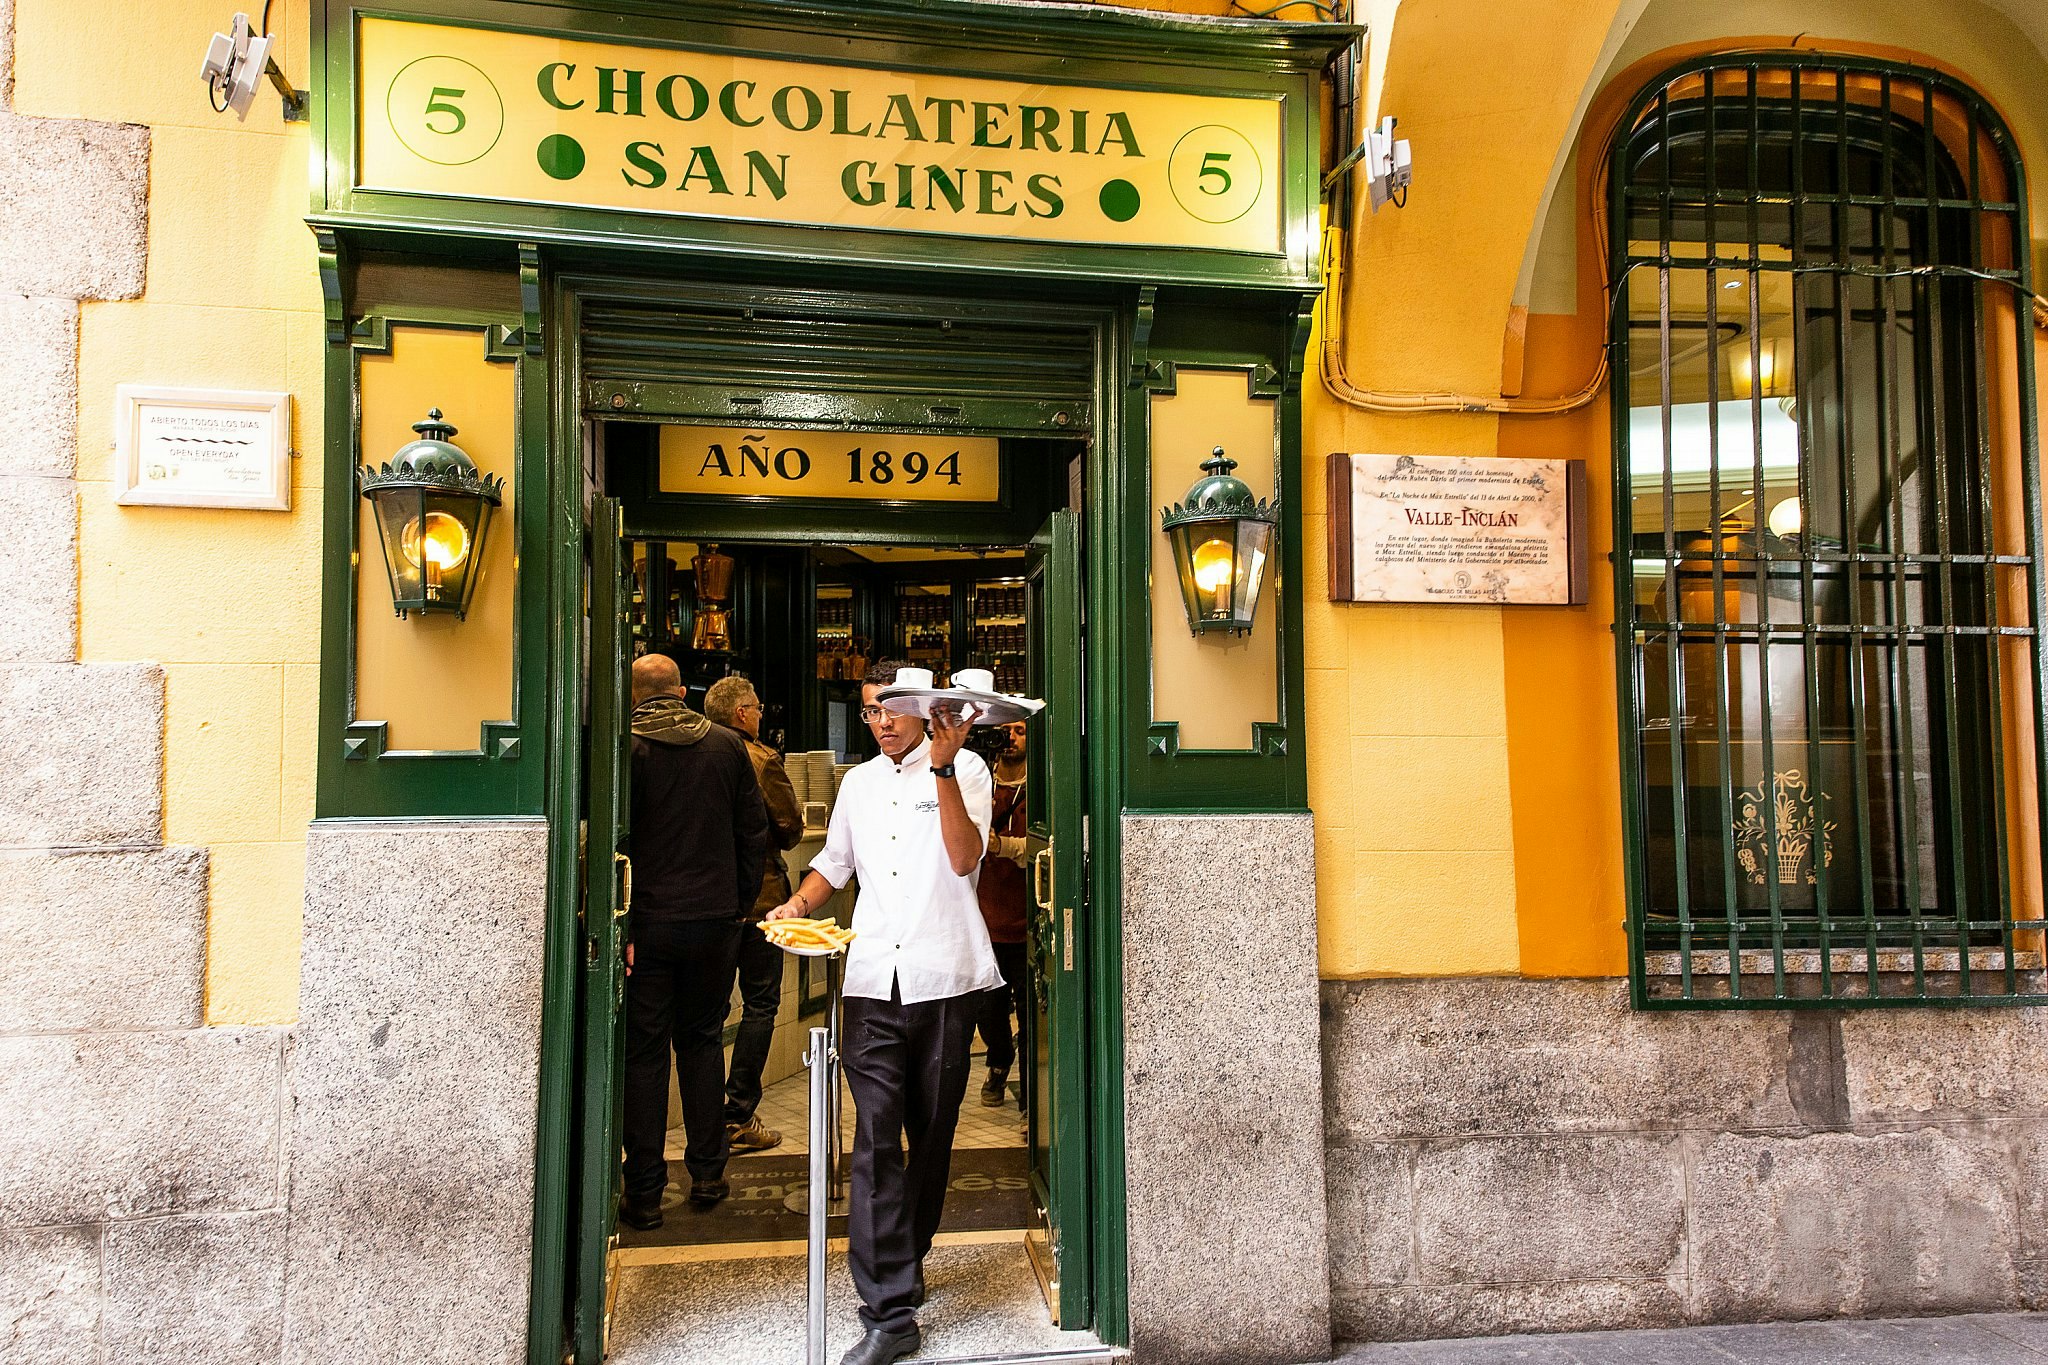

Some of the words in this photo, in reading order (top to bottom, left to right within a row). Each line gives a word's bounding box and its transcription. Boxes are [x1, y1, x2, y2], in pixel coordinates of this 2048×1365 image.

[424, 87, 466, 135] 5
[536, 61, 1145, 157] CHOCOLATERIA
[622, 142, 788, 201] SAN
[840, 161, 1063, 220] GINES
[1197, 152, 1233, 196] 5
[150, 417, 188, 425] ABIERTO
[190, 419, 219, 427] TODOS
[221, 420, 238, 428] LOS
[169, 448, 193, 457] OPEN
[195, 448, 240, 460] EVERYDAY
[697, 435, 811, 480] AÑO
[847, 447, 962, 486] 1894
[1456, 476, 1477, 484] primer
[1514, 538, 1549, 546] modernista,
